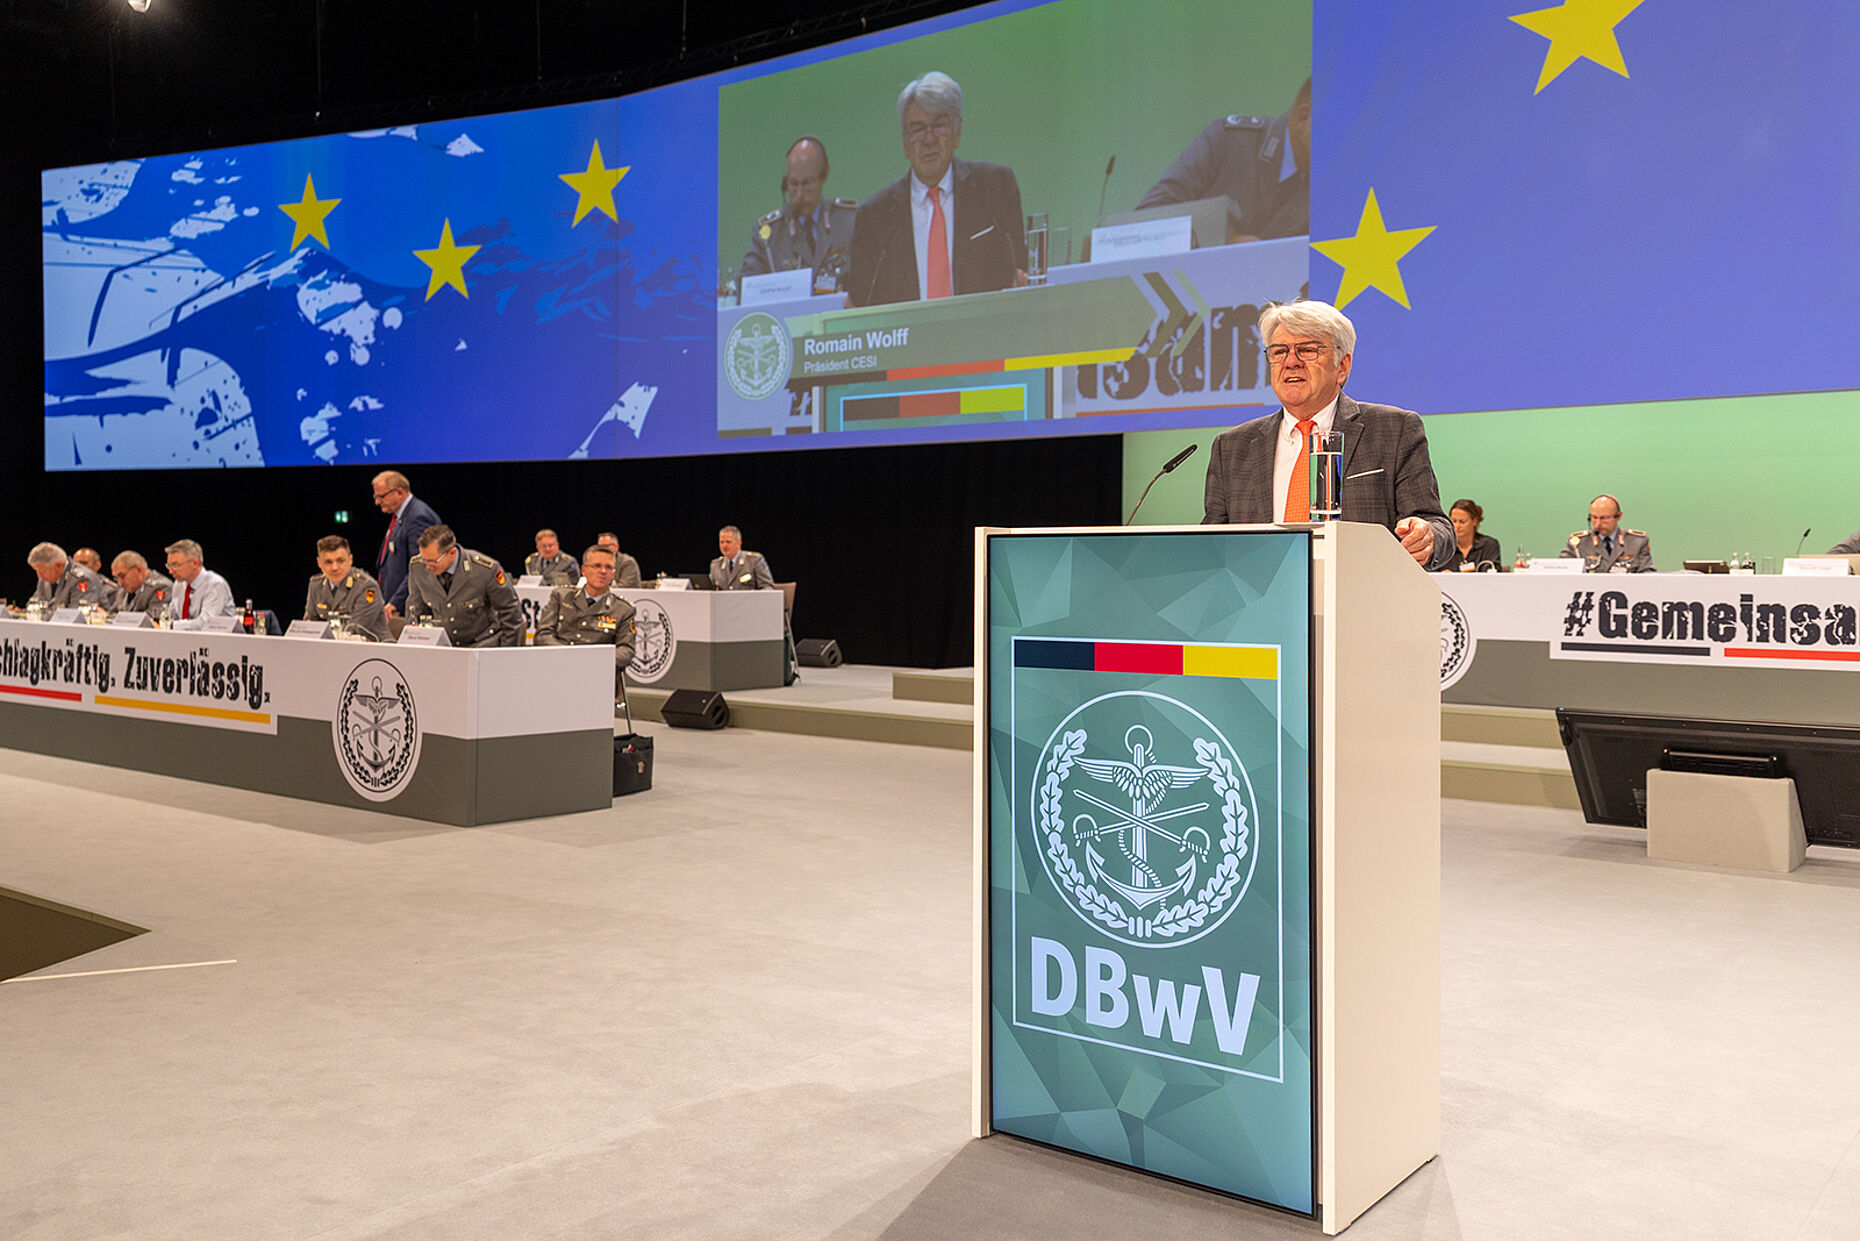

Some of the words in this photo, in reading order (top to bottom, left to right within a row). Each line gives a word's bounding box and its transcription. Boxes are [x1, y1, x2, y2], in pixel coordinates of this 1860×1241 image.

[804, 334, 862, 356] Romain
[866, 327, 909, 350] Wolff
[804, 358, 849, 373] Präsident
[851, 355, 877, 369] CESI
[1564, 590, 1860, 645] #Gemeinsa
[124, 647, 271, 710] Zuverlässig.
[1031, 936, 1261, 1056] DBwV
